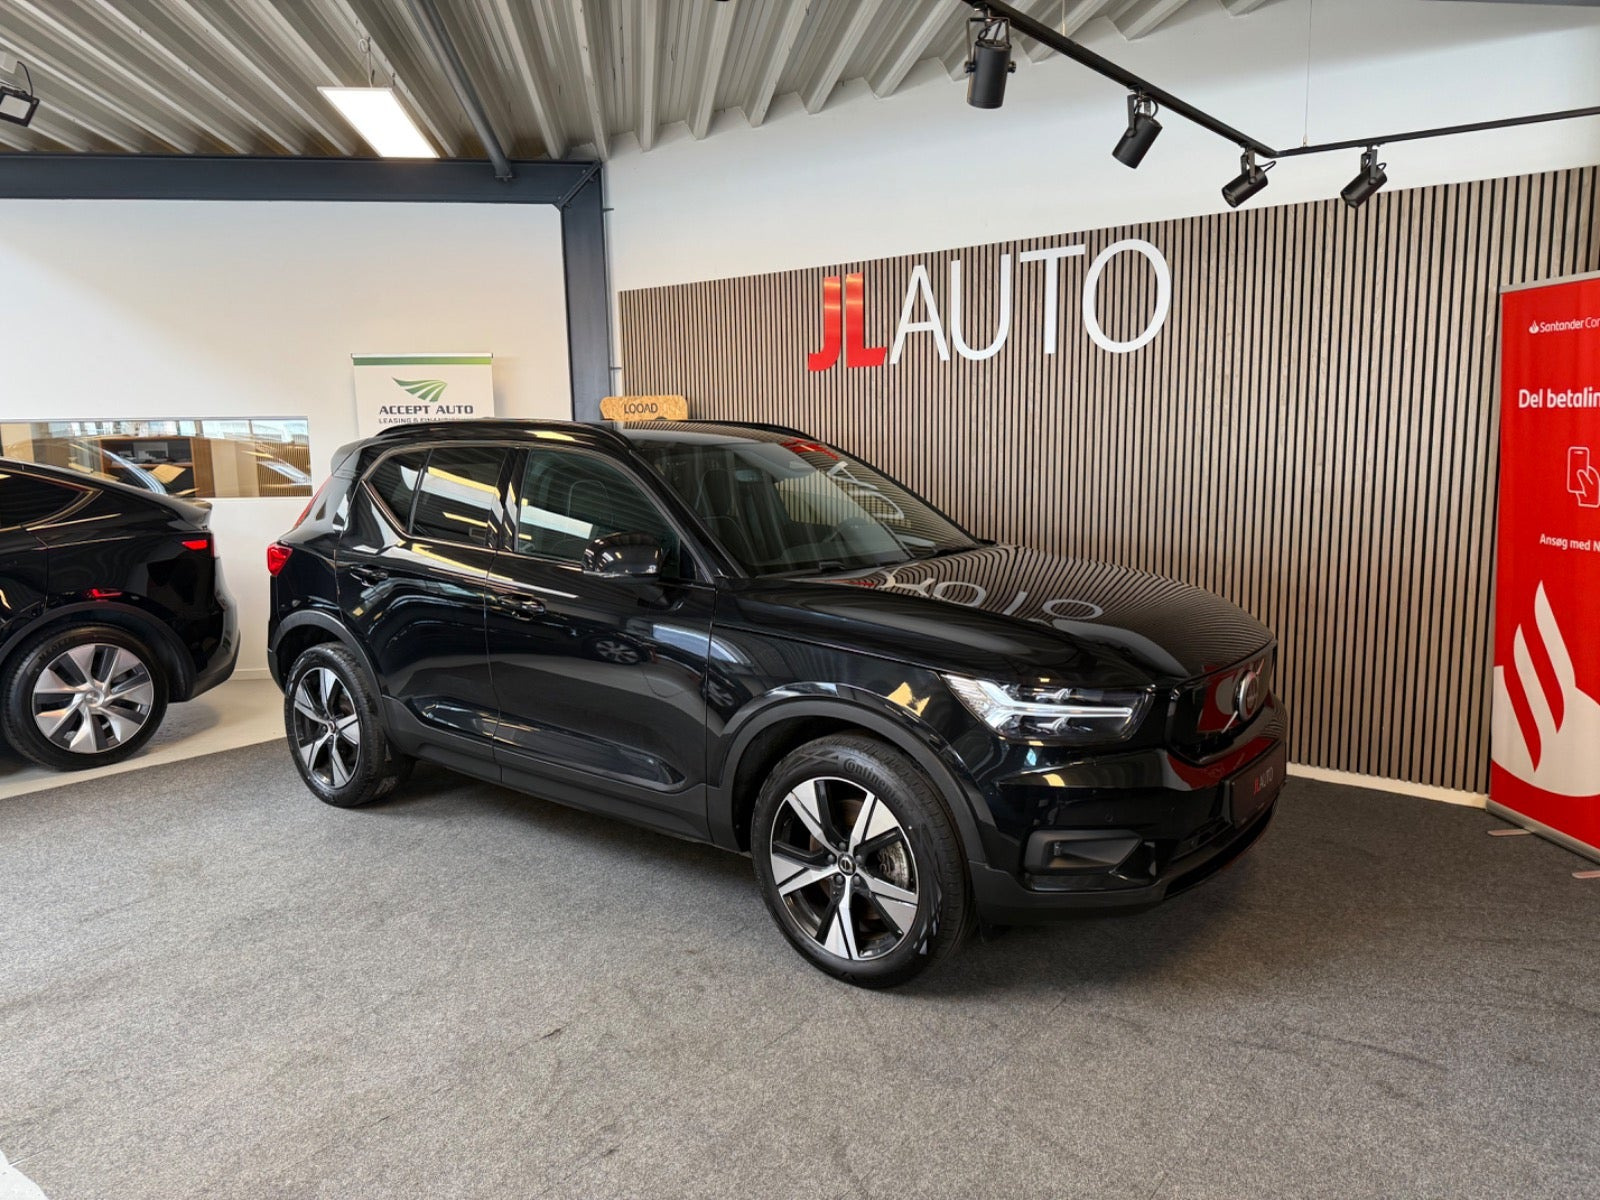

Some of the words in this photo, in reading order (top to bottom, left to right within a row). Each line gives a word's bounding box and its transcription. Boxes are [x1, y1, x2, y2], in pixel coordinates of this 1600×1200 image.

[1540, 319, 1584, 333] Santander
[1519, 388, 1543, 408] Del
[379, 405, 430, 415] ACCEPT
[435, 405, 474, 414] AUTO
[623, 403, 658, 414] LOOAD
[1540, 533, 1568, 550] Ansøg
[1570, 540, 1590, 551] med
